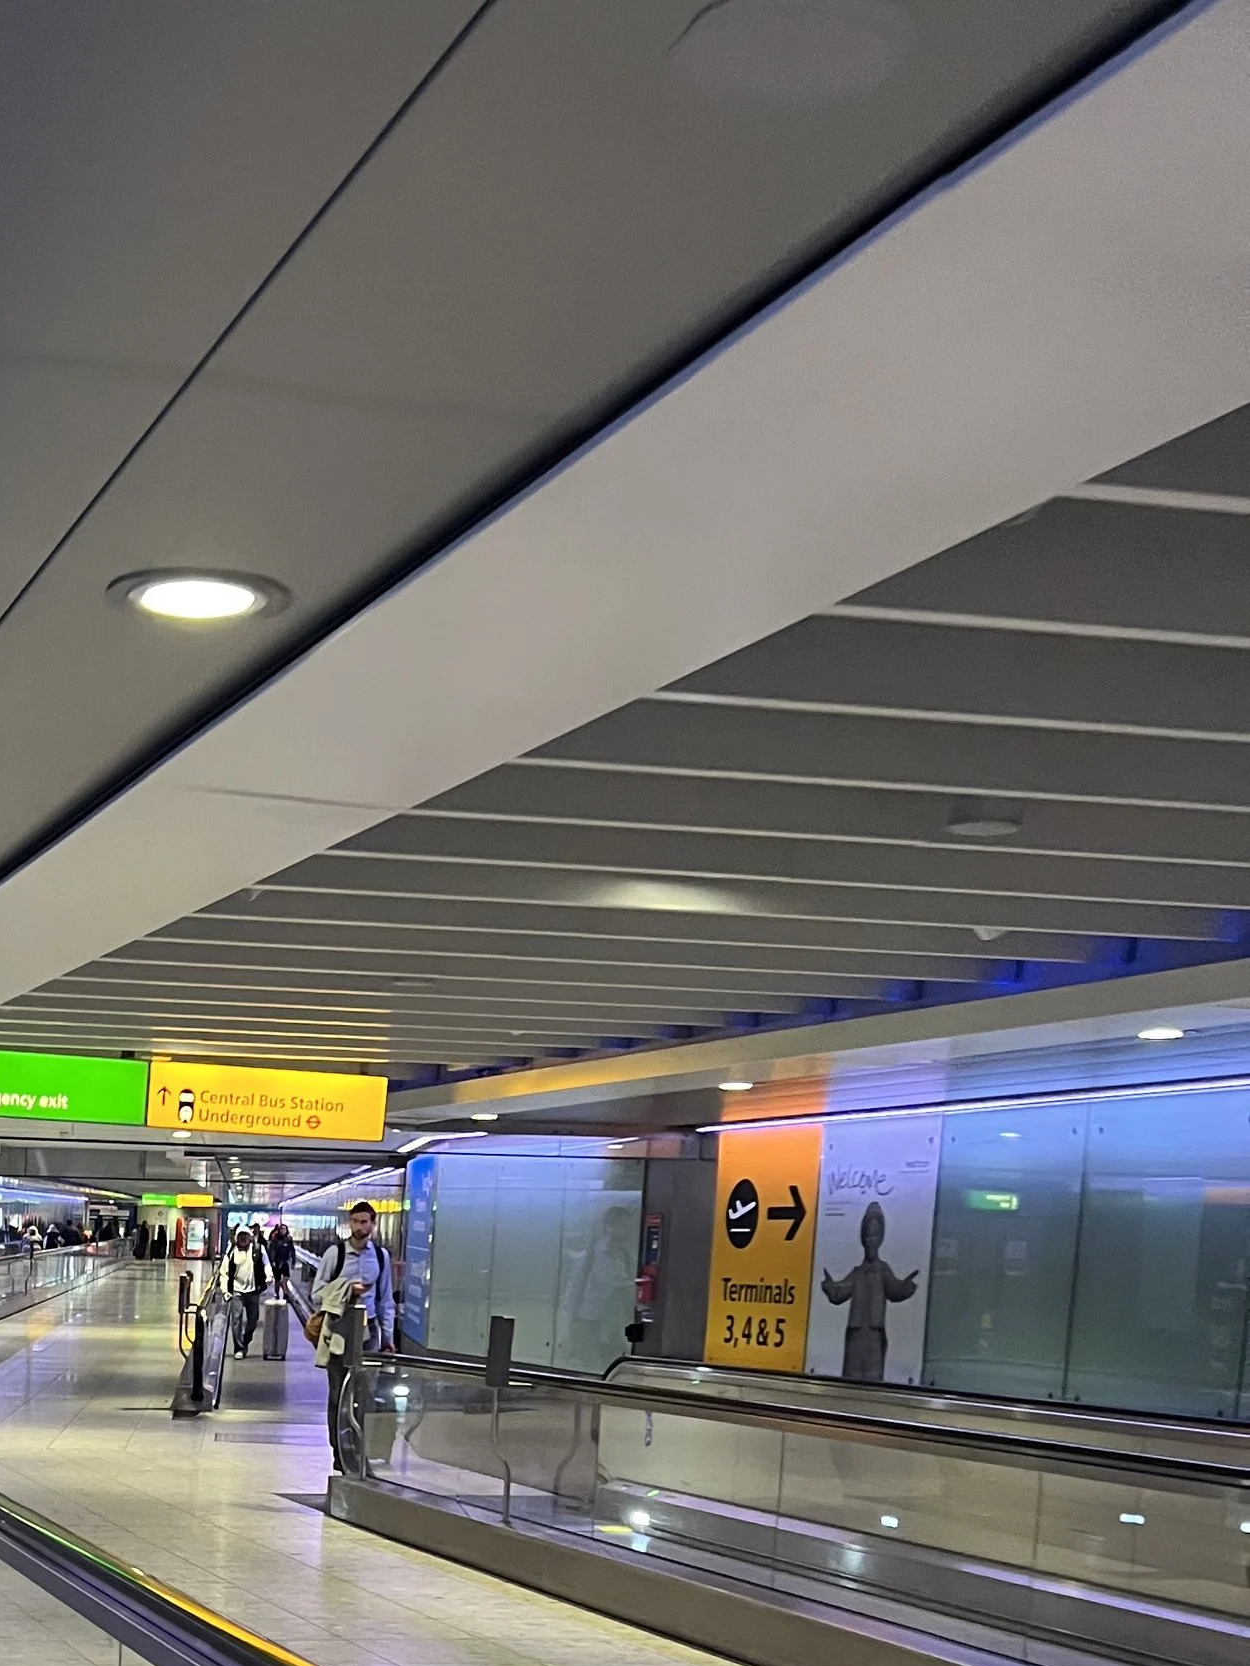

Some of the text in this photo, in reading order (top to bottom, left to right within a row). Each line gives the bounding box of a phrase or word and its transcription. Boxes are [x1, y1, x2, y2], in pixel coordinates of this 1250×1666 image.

[38, 1093, 69, 1110] exit
[200, 1090, 344, 1113] Central Bus Station
[198, 1109, 301, 1128] Underground
[827, 1164, 895, 1196] Welcome
[722, 1277, 796, 1305] Terminals
[756, 1318, 770, 1347] &
[773, 1318, 787, 1348] 5
